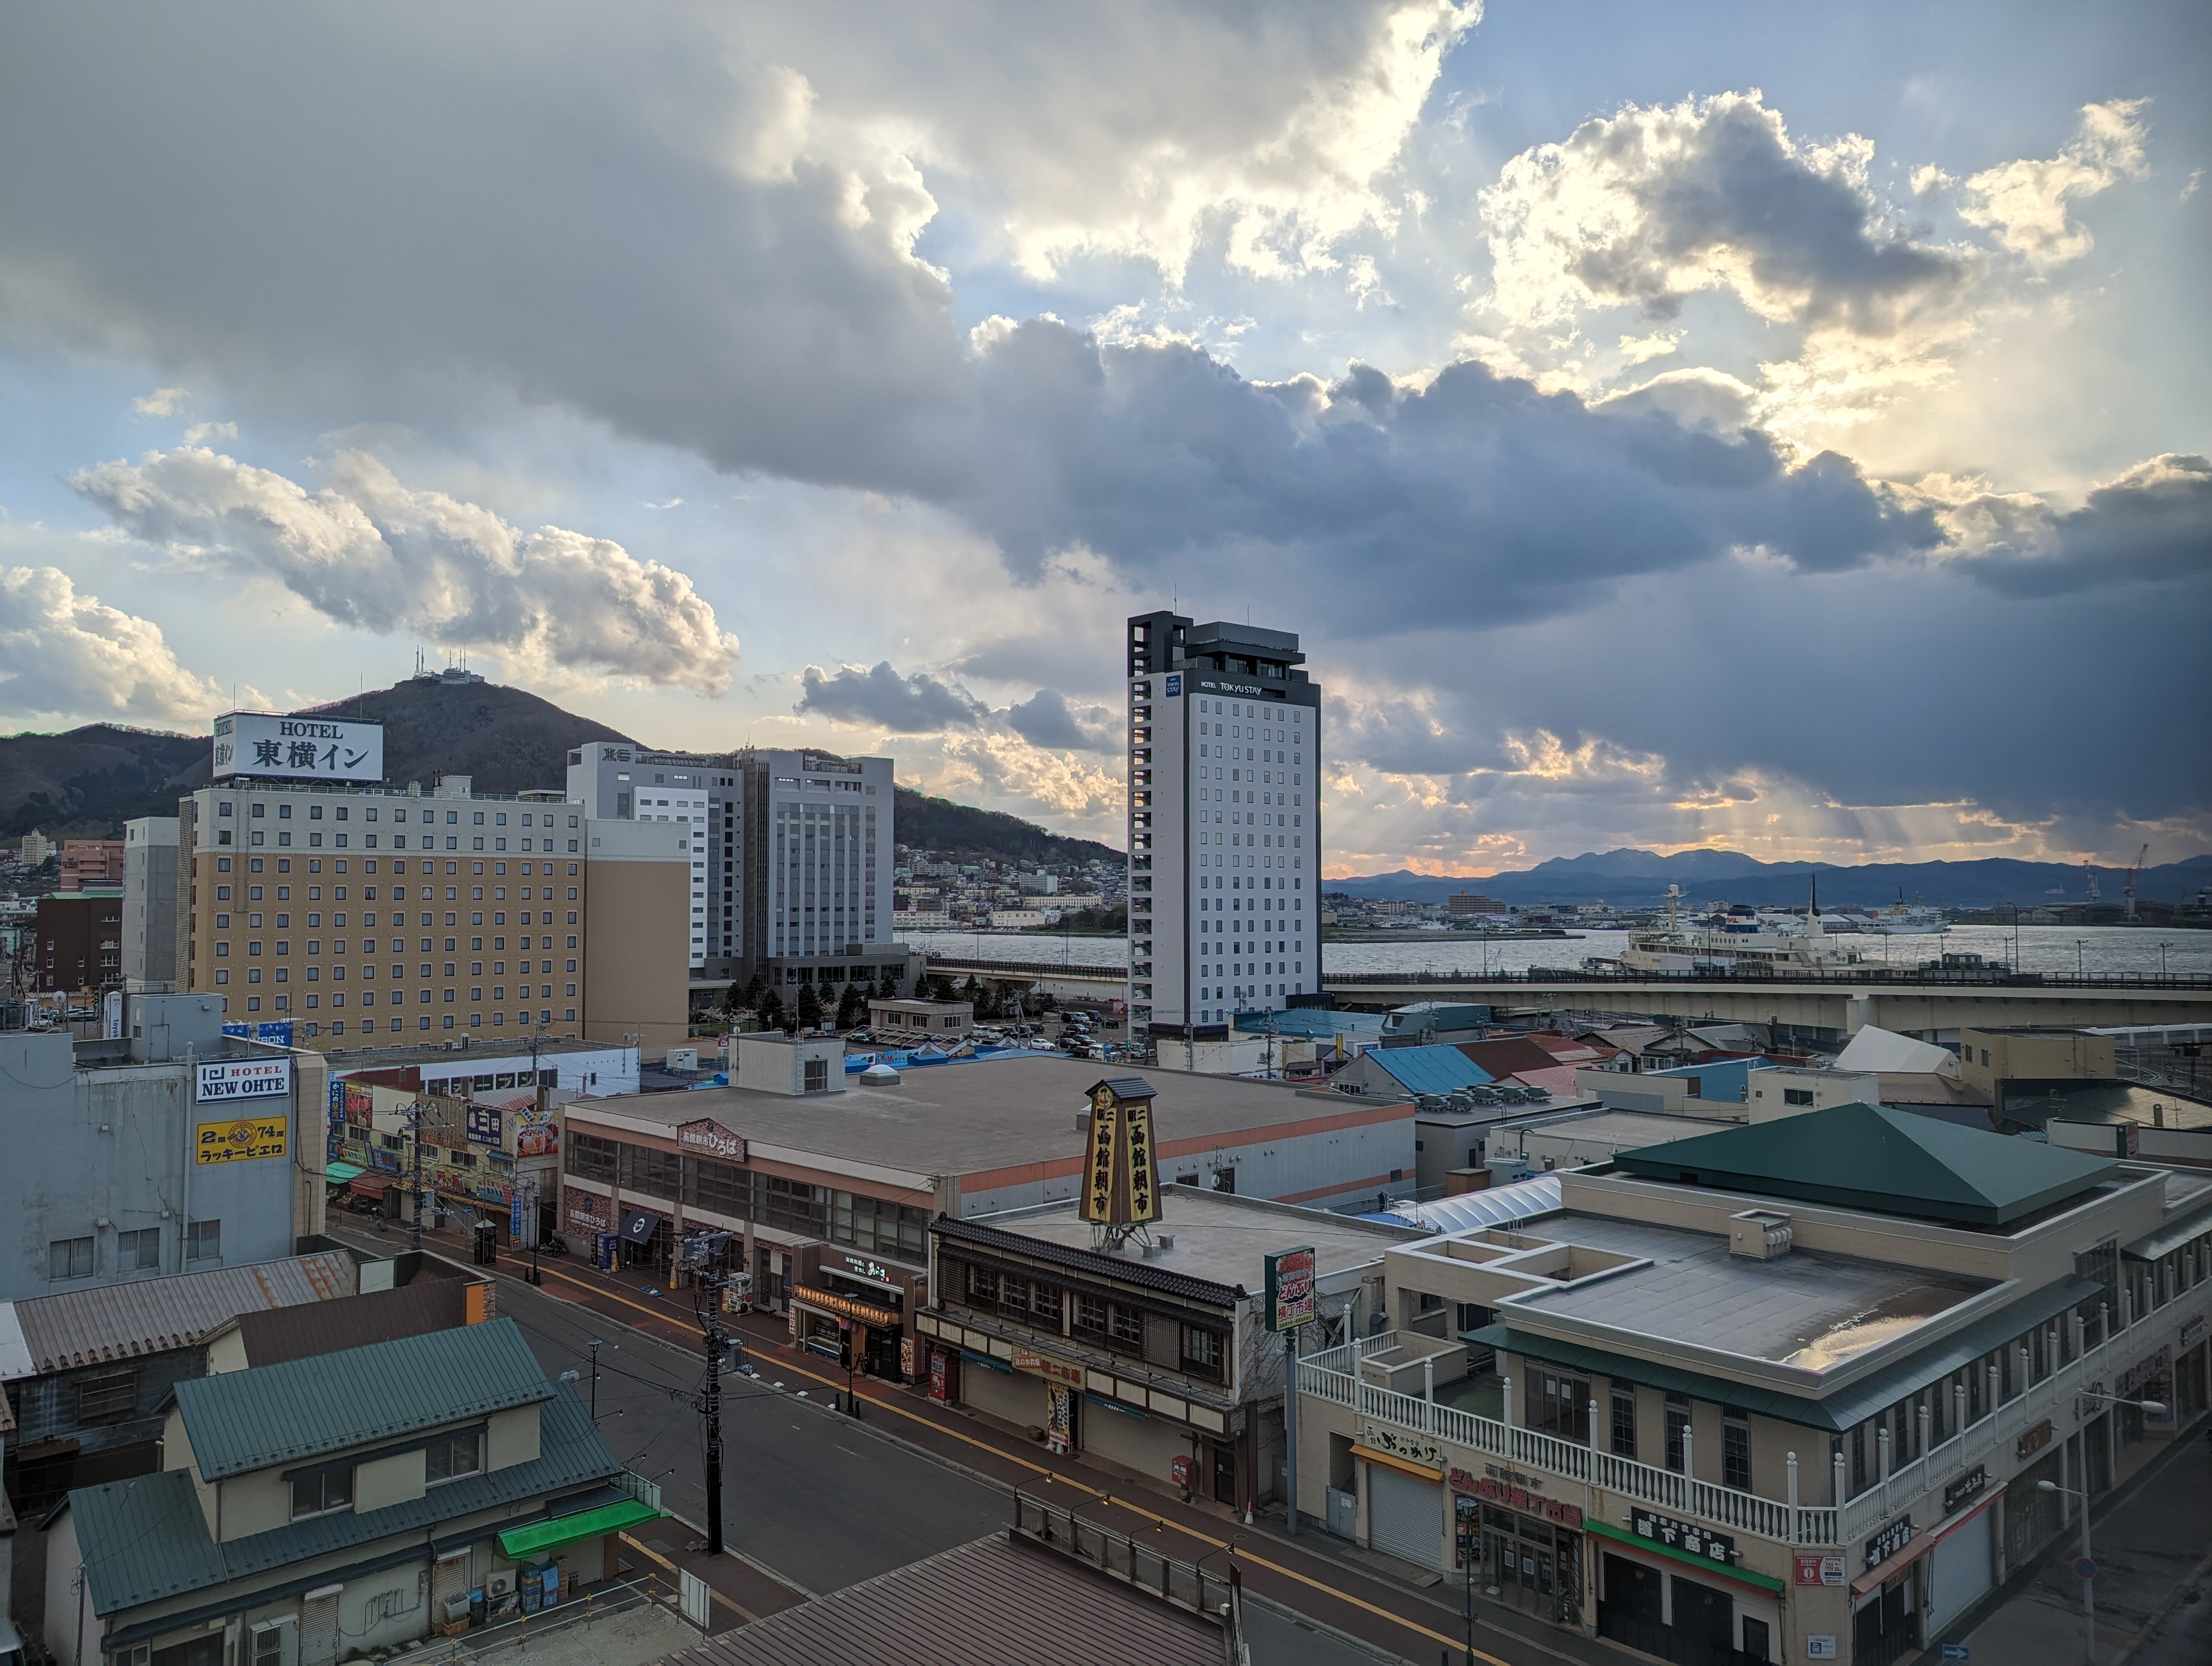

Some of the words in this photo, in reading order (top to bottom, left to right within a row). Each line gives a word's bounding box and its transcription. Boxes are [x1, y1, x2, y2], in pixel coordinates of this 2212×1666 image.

[216, 720, 233, 737] HOTEL
[280, 722, 343, 739] HOTEL
[252, 739, 369, 771] 東横イン
[230, 1066, 282, 1077] HOTEL
[202, 1081, 239, 1097] NEW
[242, 1078, 285, 1093] OHTE
[201, 1144, 282, 1162] ラッキーピエロ
[1093, 1125, 1112, 1215] 函館朝市
[1130, 1124, 1149, 1215] 函館朝市
[1278, 1279, 1313, 1301] どんぶり
[1277, 1297, 1313, 1321] 横丁市場
[1484, 1463, 1544, 1490] 函館朝市
[1448, 1467, 1583, 1528] どんぶり横丁市場
[1638, 1518, 1725, 1561] 道下商店
